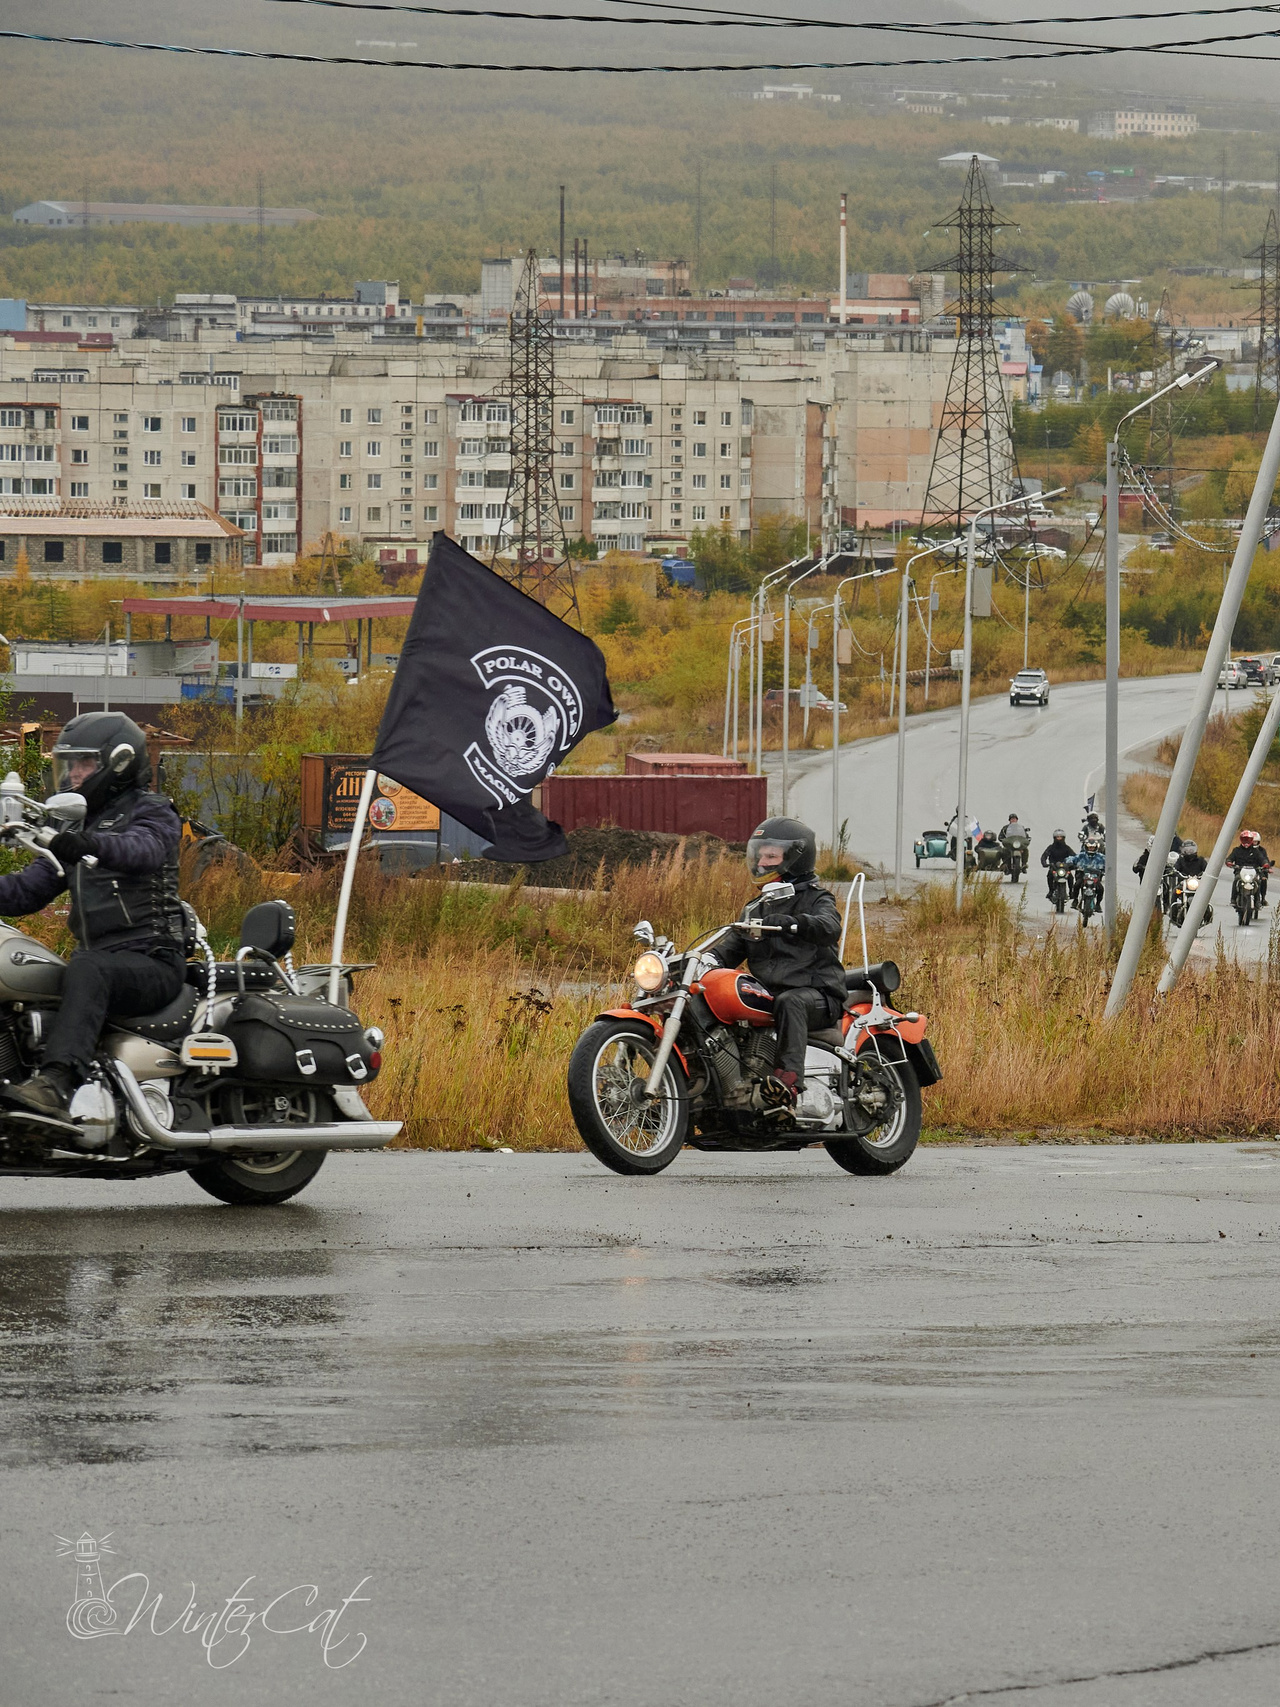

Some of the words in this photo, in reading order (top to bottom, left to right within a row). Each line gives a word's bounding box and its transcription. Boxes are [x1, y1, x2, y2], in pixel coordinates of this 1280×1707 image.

[268, 666, 281, 674] 92
[484, 657, 543, 678] POLAR
[547, 676, 578, 735] OWLS
